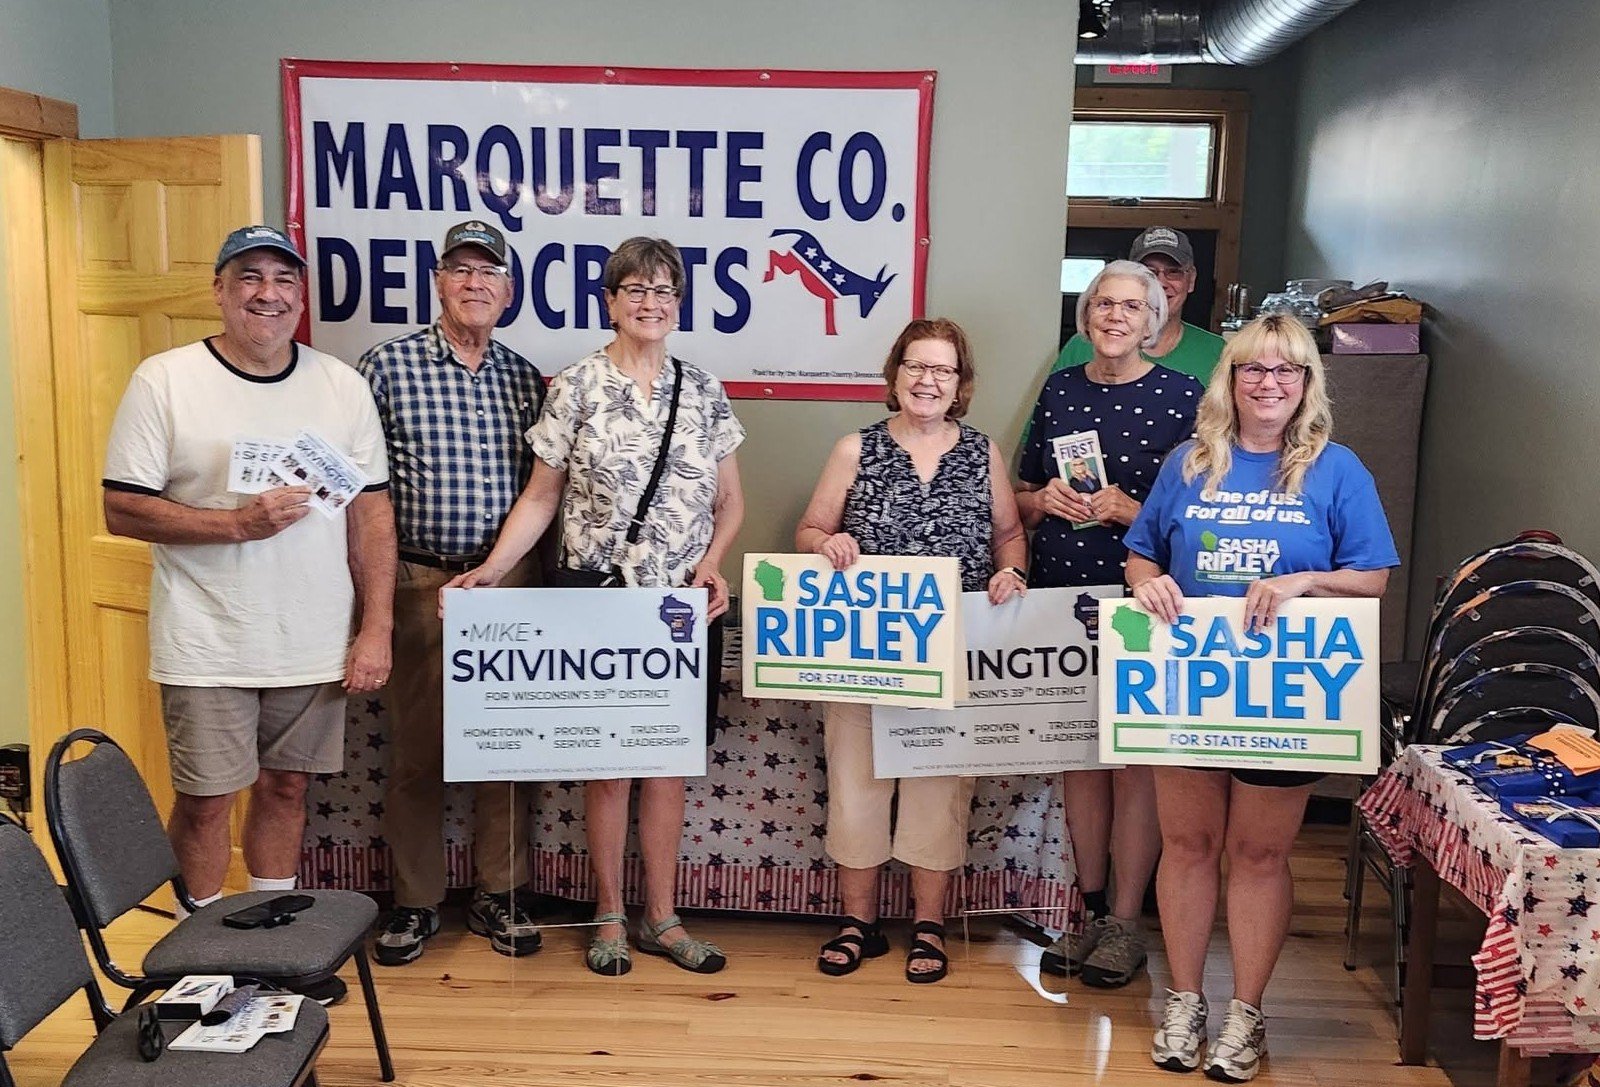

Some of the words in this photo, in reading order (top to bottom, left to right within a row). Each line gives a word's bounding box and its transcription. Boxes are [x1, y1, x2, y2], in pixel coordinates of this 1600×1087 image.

[313, 121, 764, 232] MARQUETTE
[796, 130, 906, 223] CO.
[317, 237, 752, 334] DECRTS
[1060, 441, 1095, 459] FIRST
[1244, 489, 1270, 505] of
[1185, 505, 1221, 519] For
[1220, 505, 1251, 520] all
[1250, 506, 1277, 522] of
[1277, 510, 1311, 525] us.
[1218, 538, 1280, 555] SASHA
[1197, 551, 1280, 573] RIPLEY
[798, 569, 945, 611] SASHA
[469, 622, 532, 642] MIKE
[756, 607, 945, 663] RIPLEY
[1169, 614, 1364, 659] SASHA
[452, 647, 700, 682] SKIVINGTON
[967, 645, 1098, 681] INGTO
[799, 672, 822, 683] FOR
[825, 673, 859, 686] STATE
[861, 675, 904, 688] SENATE
[486, 691, 510, 701] FOR
[512, 690, 590, 700] WISCONSIN'S
[618, 689, 671, 699] DISTRICT
[1036, 685, 1087, 697] DISTRICT
[1115, 659, 1363, 721] RIPLEY
[463, 727, 534, 738] HOMETOWN
[554, 726, 601, 737] PROVEN
[630, 725, 680, 734] TRUSTED
[889, 726, 956, 737] HOMETOWN
[974, 723, 1020, 733] PROVEN
[1048, 720, 1098, 730] TRUSTED
[476, 740, 521, 750] VALUES
[553, 739, 601, 749] SERVICE
[620, 737, 690, 748] LEADERSHIP
[901, 738, 943, 748] VALUES
[974, 735, 1020, 745] SERVICE
[1039, 732, 1098, 742] LEADERSH
[1170, 733, 1199, 746] FOR
[1204, 734, 1247, 748] STATE
[1250, 737, 1308, 750] SENATE
